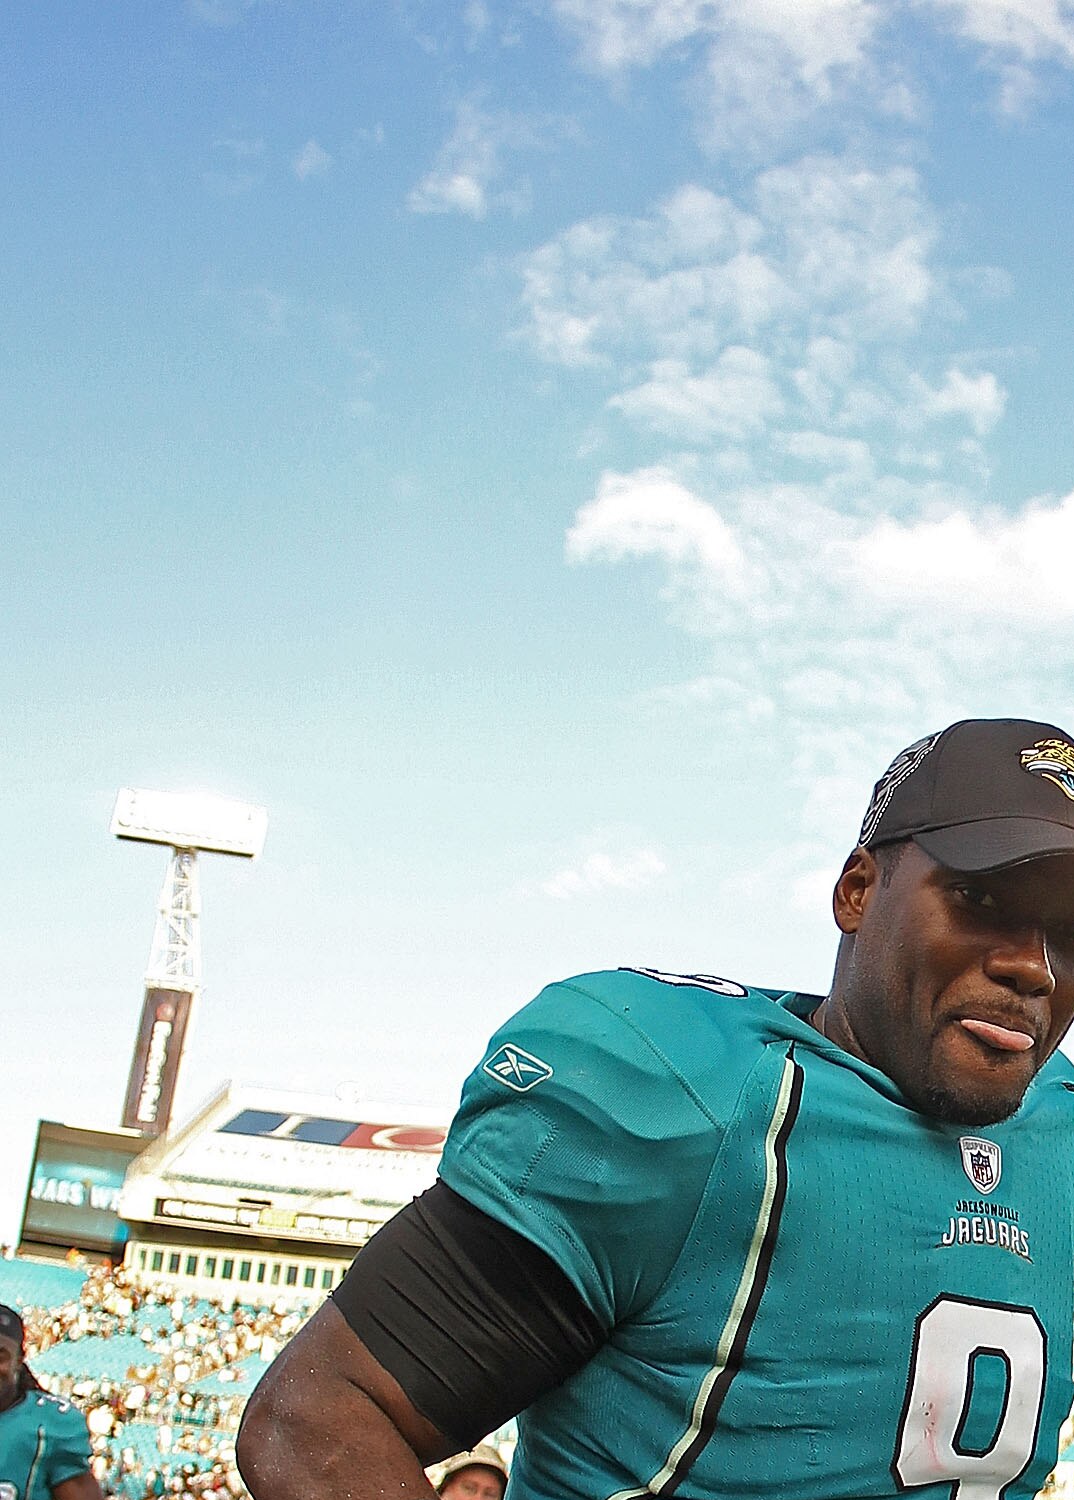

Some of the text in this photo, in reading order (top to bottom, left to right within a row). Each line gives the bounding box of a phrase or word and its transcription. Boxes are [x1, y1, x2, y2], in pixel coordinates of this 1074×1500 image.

[974, 1164, 993, 1181] NFL
[955, 1200, 1019, 1222] JACKSONVILLE
[941, 1216, 1030, 1258] JAGUARS
